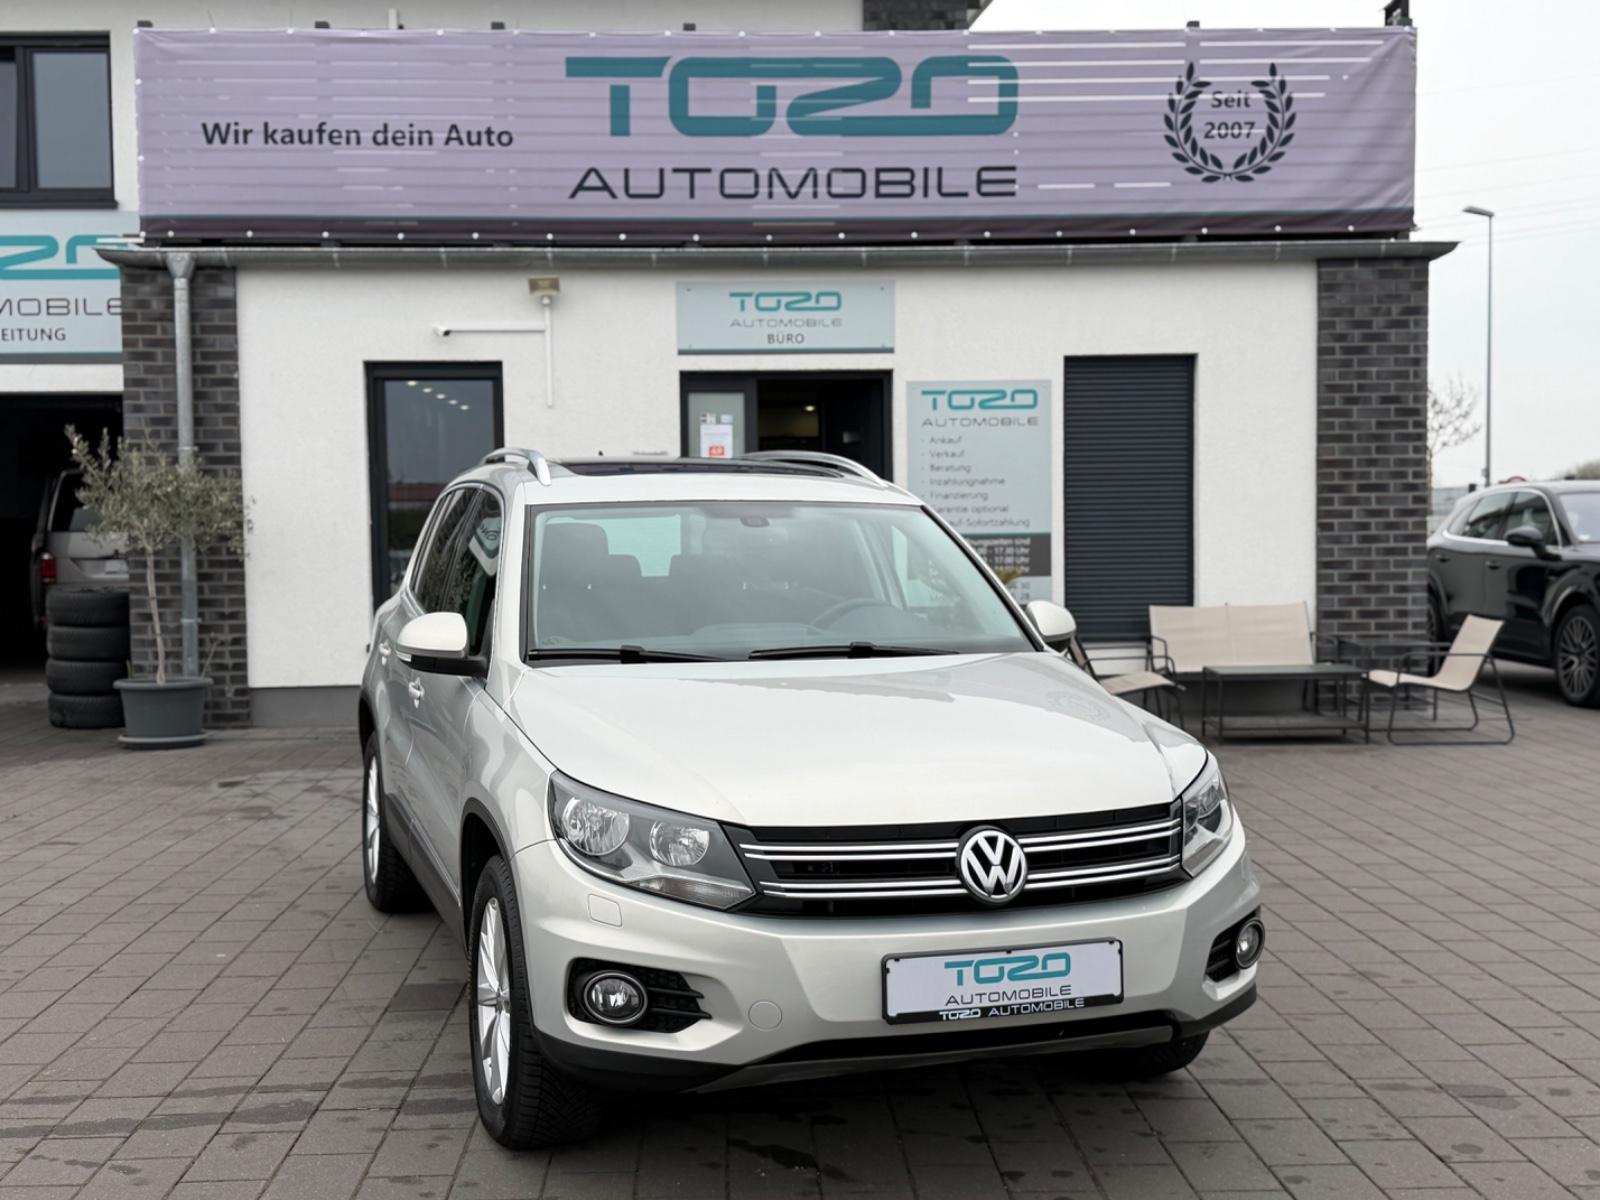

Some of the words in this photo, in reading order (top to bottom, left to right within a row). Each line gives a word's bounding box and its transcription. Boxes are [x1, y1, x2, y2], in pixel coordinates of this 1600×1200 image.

[1210, 90, 1251, 108] Seit
[201, 122, 253, 145] Wir
[264, 122, 361, 146] kaufen
[372, 122, 433, 147] dein
[444, 124, 514, 147] Auto
[1203, 121, 1256, 139] 2007
[568, 166, 1017, 199] AUTOMOBILE
[729, 318, 843, 328] AUTOMOBILE
[767, 333, 805, 344] BÜRO
[921, 416, 1039, 427] AUTOMOBILE
[930, 436, 962, 444] Ankauf
[929, 450, 965, 458] Verkauf
[930, 464, 971, 473] Beratung
[930, 478, 1006, 487] Inzahlungnahme
[930, 491, 989, 501] Finanzierung
[971, 504, 1009, 514] optional
[961, 829, 1026, 898] VW
[945, 984, 1072, 1007] AUTOMOBILE
[988, 997, 1085, 1018] AUTOMOBILE
